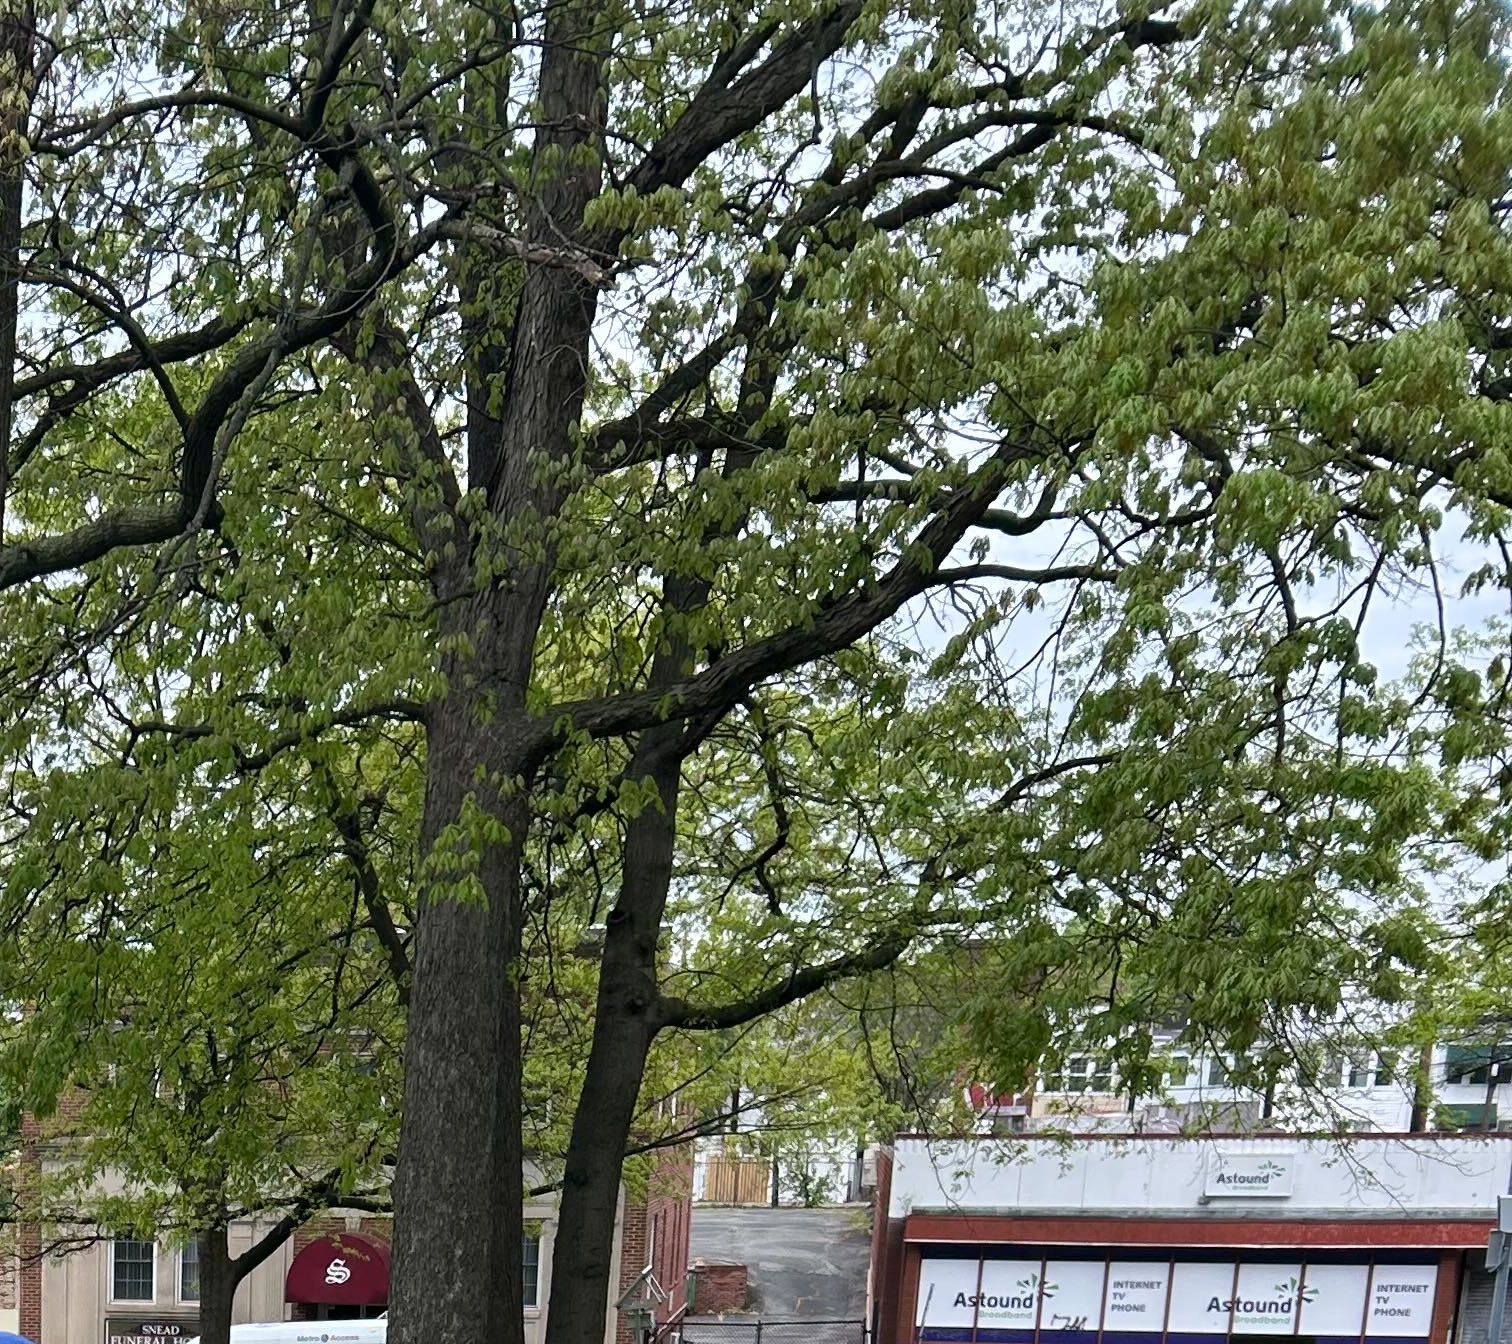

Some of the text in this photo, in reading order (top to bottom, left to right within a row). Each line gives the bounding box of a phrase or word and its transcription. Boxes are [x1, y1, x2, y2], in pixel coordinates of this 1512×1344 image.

[1216, 1172, 1270, 1184] Astound
[325, 1258, 351, 1284] S
[1113, 1280, 1163, 1290] INTERNET
[1376, 1283, 1429, 1293] INTERNET
[953, 1291, 1034, 1309] Astound
[1113, 1292, 1126, 1301] TV
[1375, 1296, 1390, 1305] TV
[1111, 1303, 1146, 1313] PHONE
[1206, 1296, 1292, 1314] Astound
[979, 1310, 1033, 1320] Broadband
[1374, 1308, 1411, 1317] PHONE
[141, 1325, 180, 1335] SNEAD
